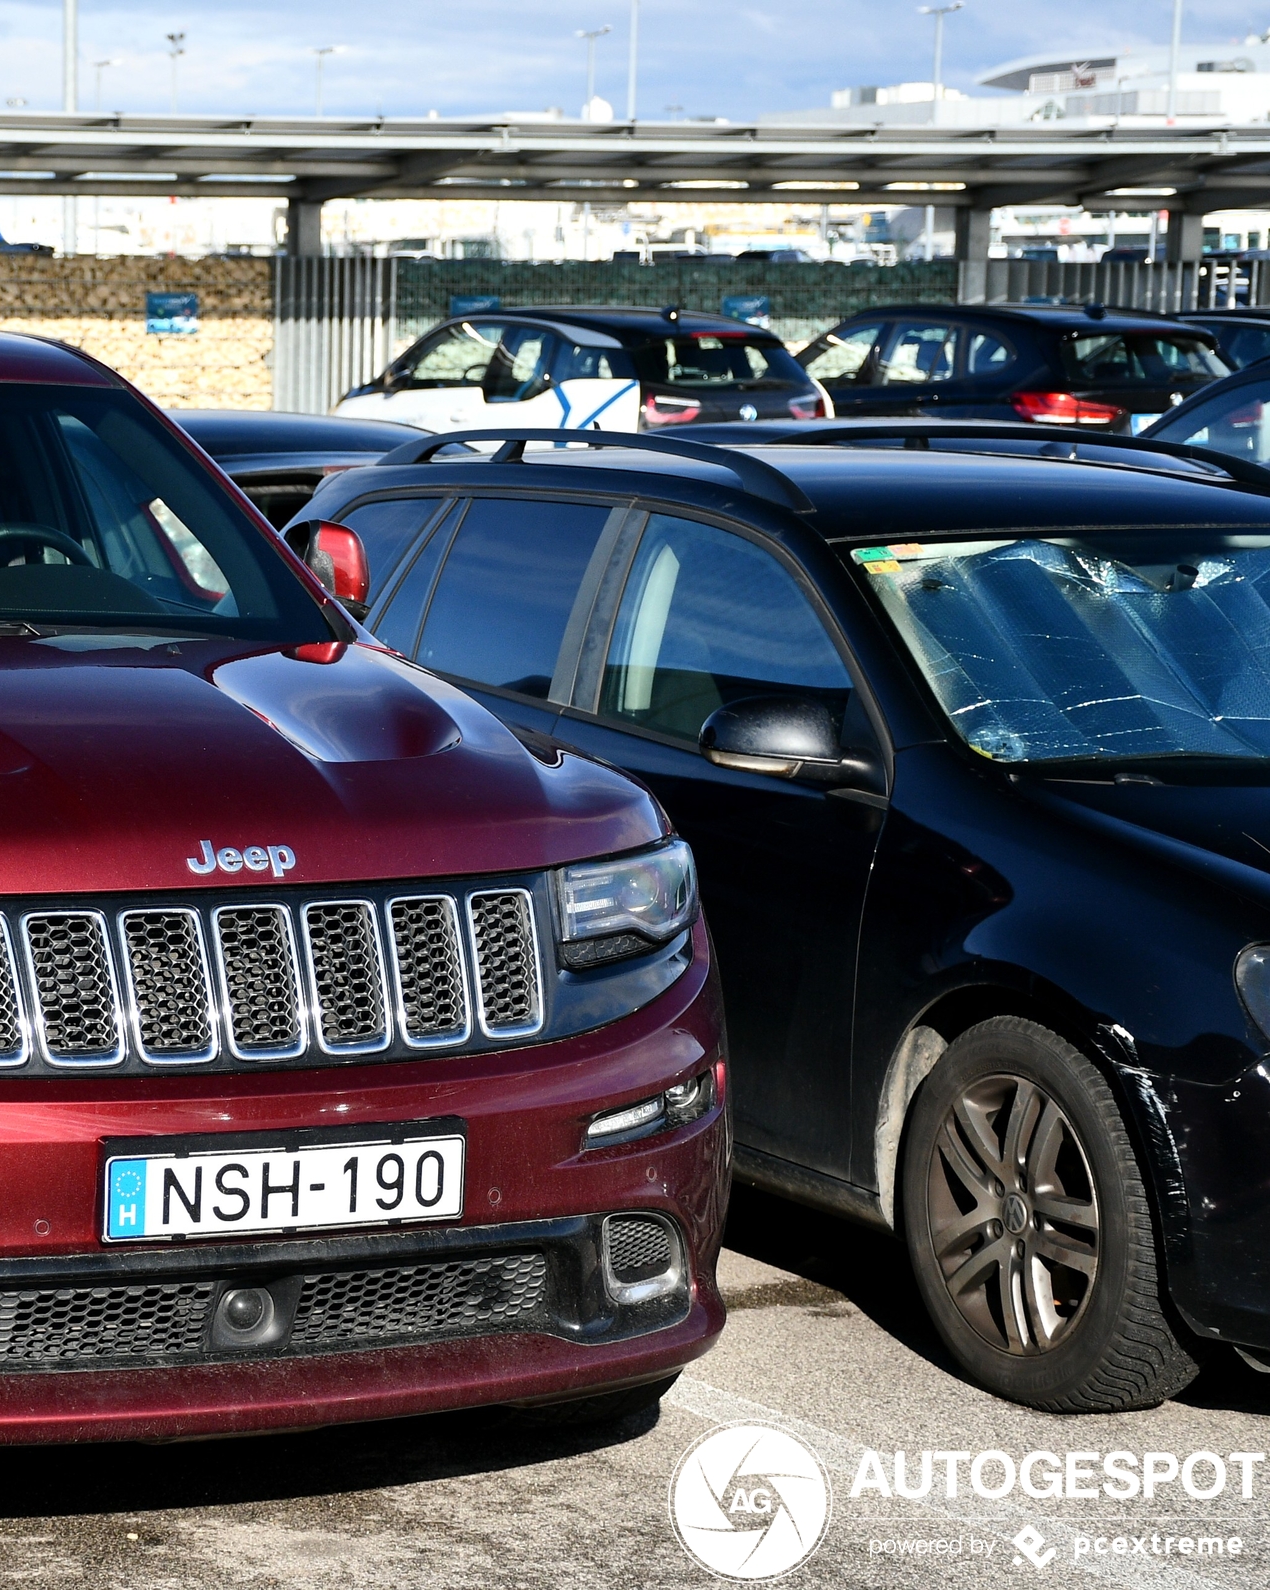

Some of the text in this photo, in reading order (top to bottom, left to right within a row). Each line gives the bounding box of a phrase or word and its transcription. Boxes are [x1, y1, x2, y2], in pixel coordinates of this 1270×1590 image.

[186, 838, 297, 878] Jeep
[161, 1149, 445, 1225] NSH-190
[118, 1203, 137, 1227] H
